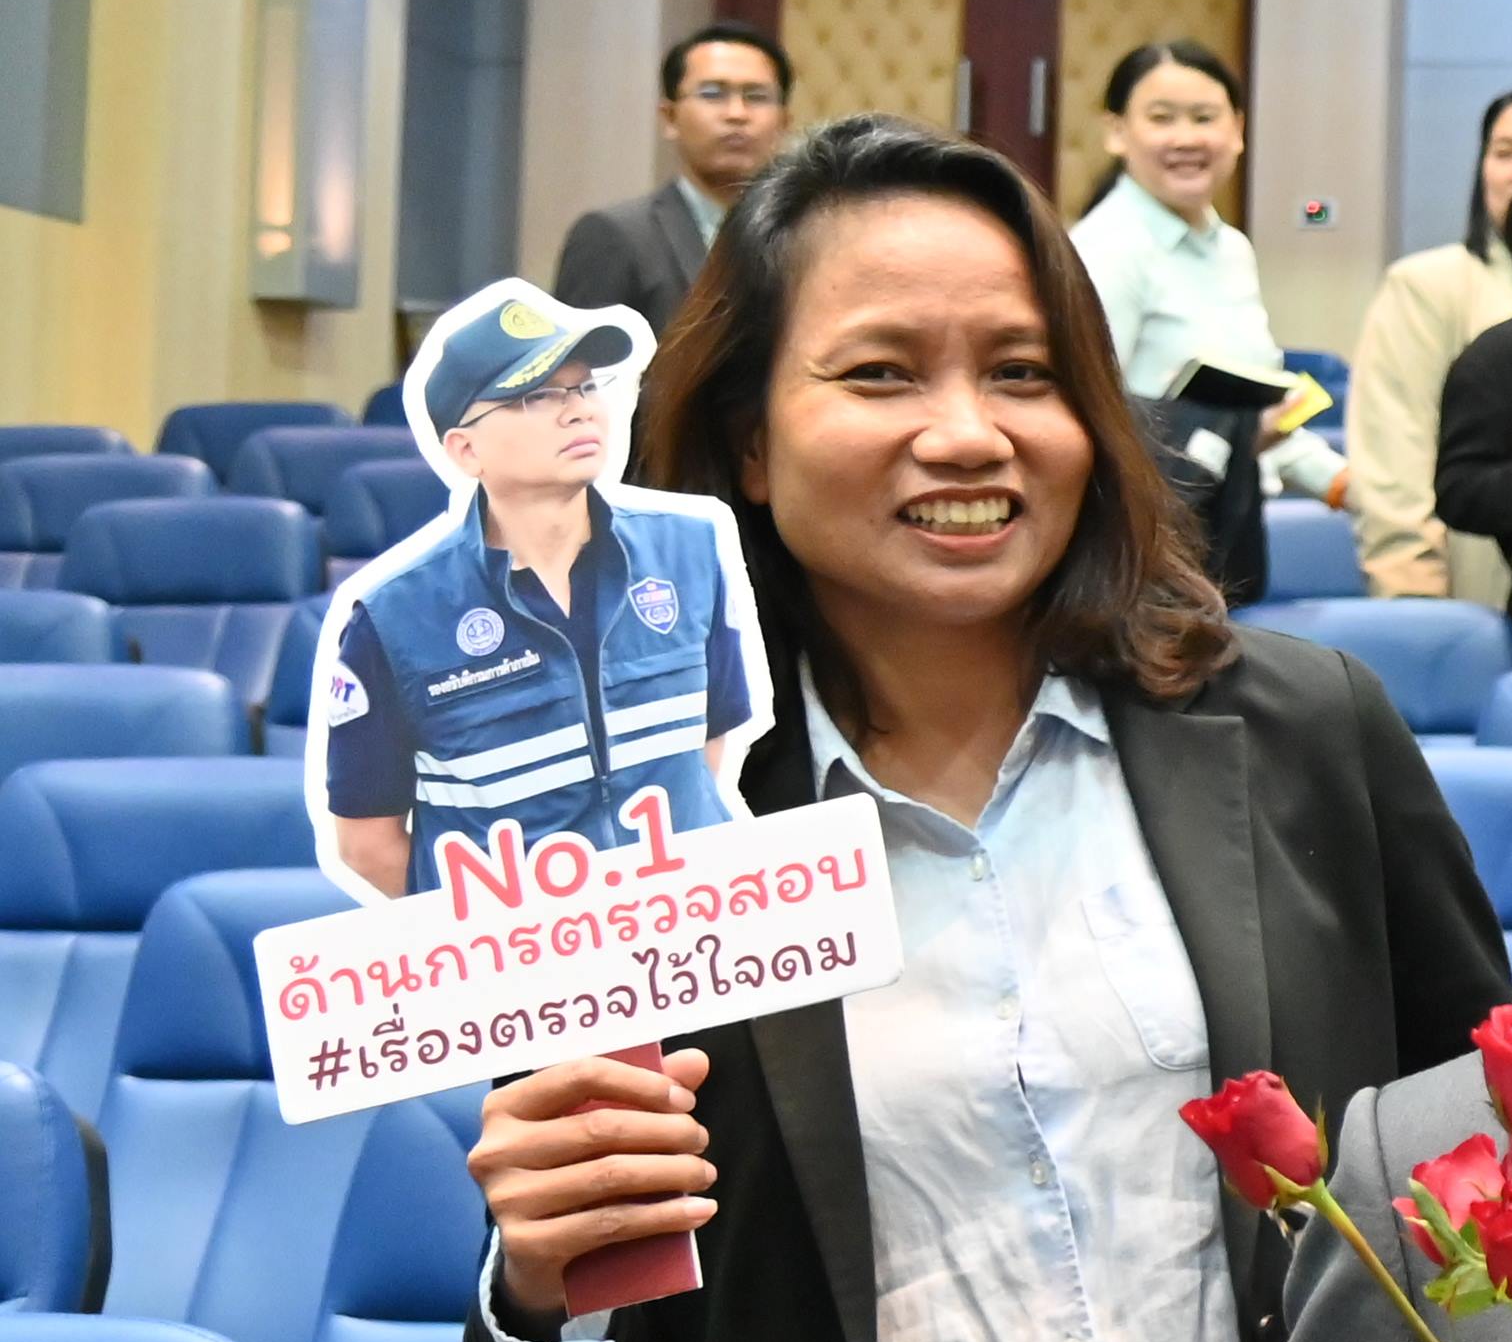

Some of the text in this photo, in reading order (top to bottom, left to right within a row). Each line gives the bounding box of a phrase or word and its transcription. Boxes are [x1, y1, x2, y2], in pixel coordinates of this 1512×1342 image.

[279, 845, 868, 1021] ด้านการตรวจสอบ
[443, 795, 685, 920] No.1
[309, 927, 858, 1090] #เรื่องตรวจไว้ใจดม
